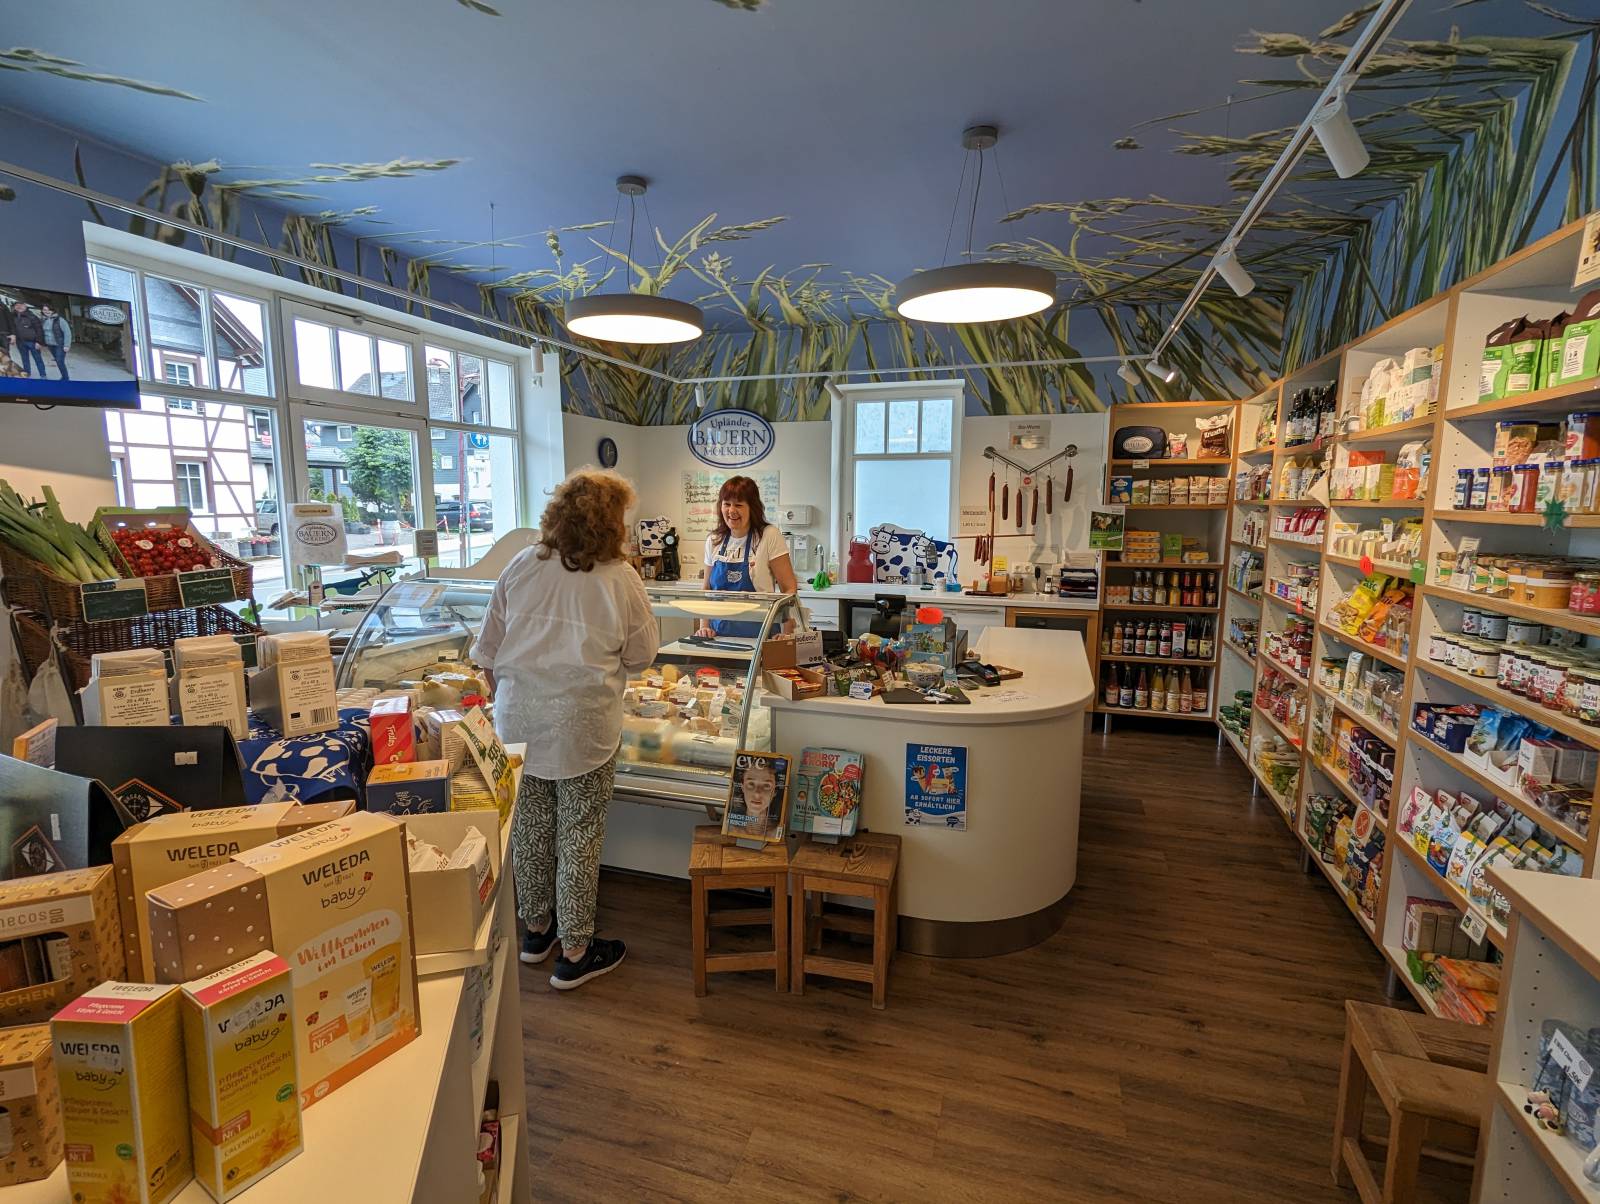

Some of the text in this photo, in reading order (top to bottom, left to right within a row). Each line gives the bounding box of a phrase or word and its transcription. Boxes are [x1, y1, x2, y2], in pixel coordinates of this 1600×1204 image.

[710, 416, 751, 429] Upländer
[695, 430, 766, 446] BAUERN
[703, 446, 758, 456] MOLKEREI
[920, 746, 953, 755] LECKERE
[736, 754, 766, 770] eve
[916, 755, 956, 764] EISSORTEN
[190, 807, 257, 818] WELEDA
[270, 823, 339, 848] WELEDA
[166, 841, 240, 862] WELEDA
[302, 849, 371, 886] WELEDA
[320, 886, 356, 909] baby
[234, 1029, 269, 1052] baby
[75, 1069, 108, 1085] baby
